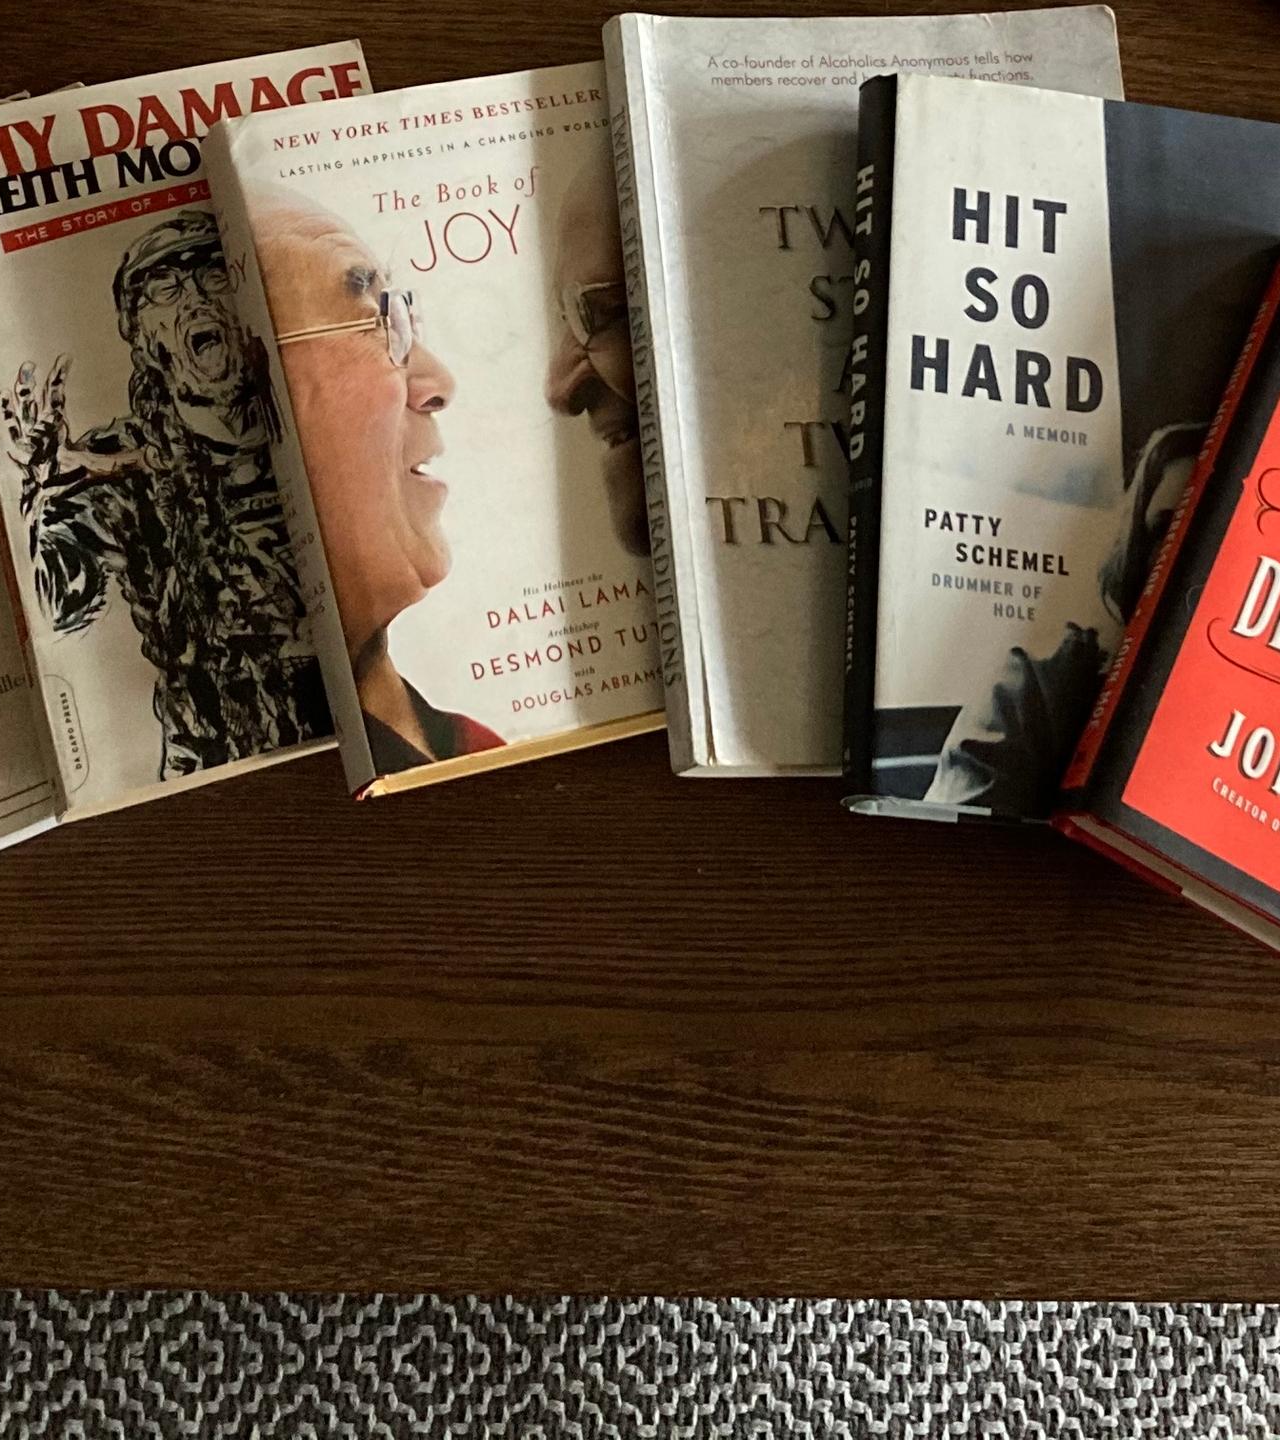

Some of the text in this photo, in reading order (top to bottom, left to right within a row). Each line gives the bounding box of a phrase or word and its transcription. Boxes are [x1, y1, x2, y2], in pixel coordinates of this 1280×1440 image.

[708, 51, 1034, 70] A co-founder of Alcoholics Anonymous tells how
[711, 74, 773, 87] members
[777, 74, 827, 87] recover
[831, 71, 857, 86] and
[79, 61, 363, 158] DAMAGE
[272, 87, 602, 151] NEW YORK TIMES BESTSELLER
[117, 136, 206, 189] MO
[279, 118, 609, 178] LASTING HAPPINESS IN A CHANGING WORLD
[373, 166, 540, 214] The Book of
[856, 164, 874, 237] HIT
[14, 226, 48, 243] THE
[62, 208, 118, 231] STORY
[130, 198, 150, 212] OF
[166, 192, 176, 203] A
[410, 204, 520, 272] JOY
[952, 187, 1067, 254] HIT
[853, 258, 871, 316] SO
[963, 266, 1050, 330] SO
[910, 334, 1103, 413] HARD
[849, 334, 869, 461] HARD
[1006, 423, 1088, 446] A MEMOIR
[924, 508, 1002, 537] PATTY
[956, 543, 1070, 577] SCHEMEL
[487, 578, 649, 628] DALAI LAMA
[523, 572, 604, 597] His Holiness the
[931, 573, 1042, 599] DRUMMER OF
[547, 620, 600, 638] Archbishop
[993, 604, 1036, 621] HOLE
[471, 636, 602, 680] DESMOND
[574, 666, 596, 679] with
[60, 692, 73, 724] PRESS
[512, 682, 594, 713] DOUGLAS
[67, 726, 80, 753] CAPO
[1212, 777, 1268, 824] CREATOR
